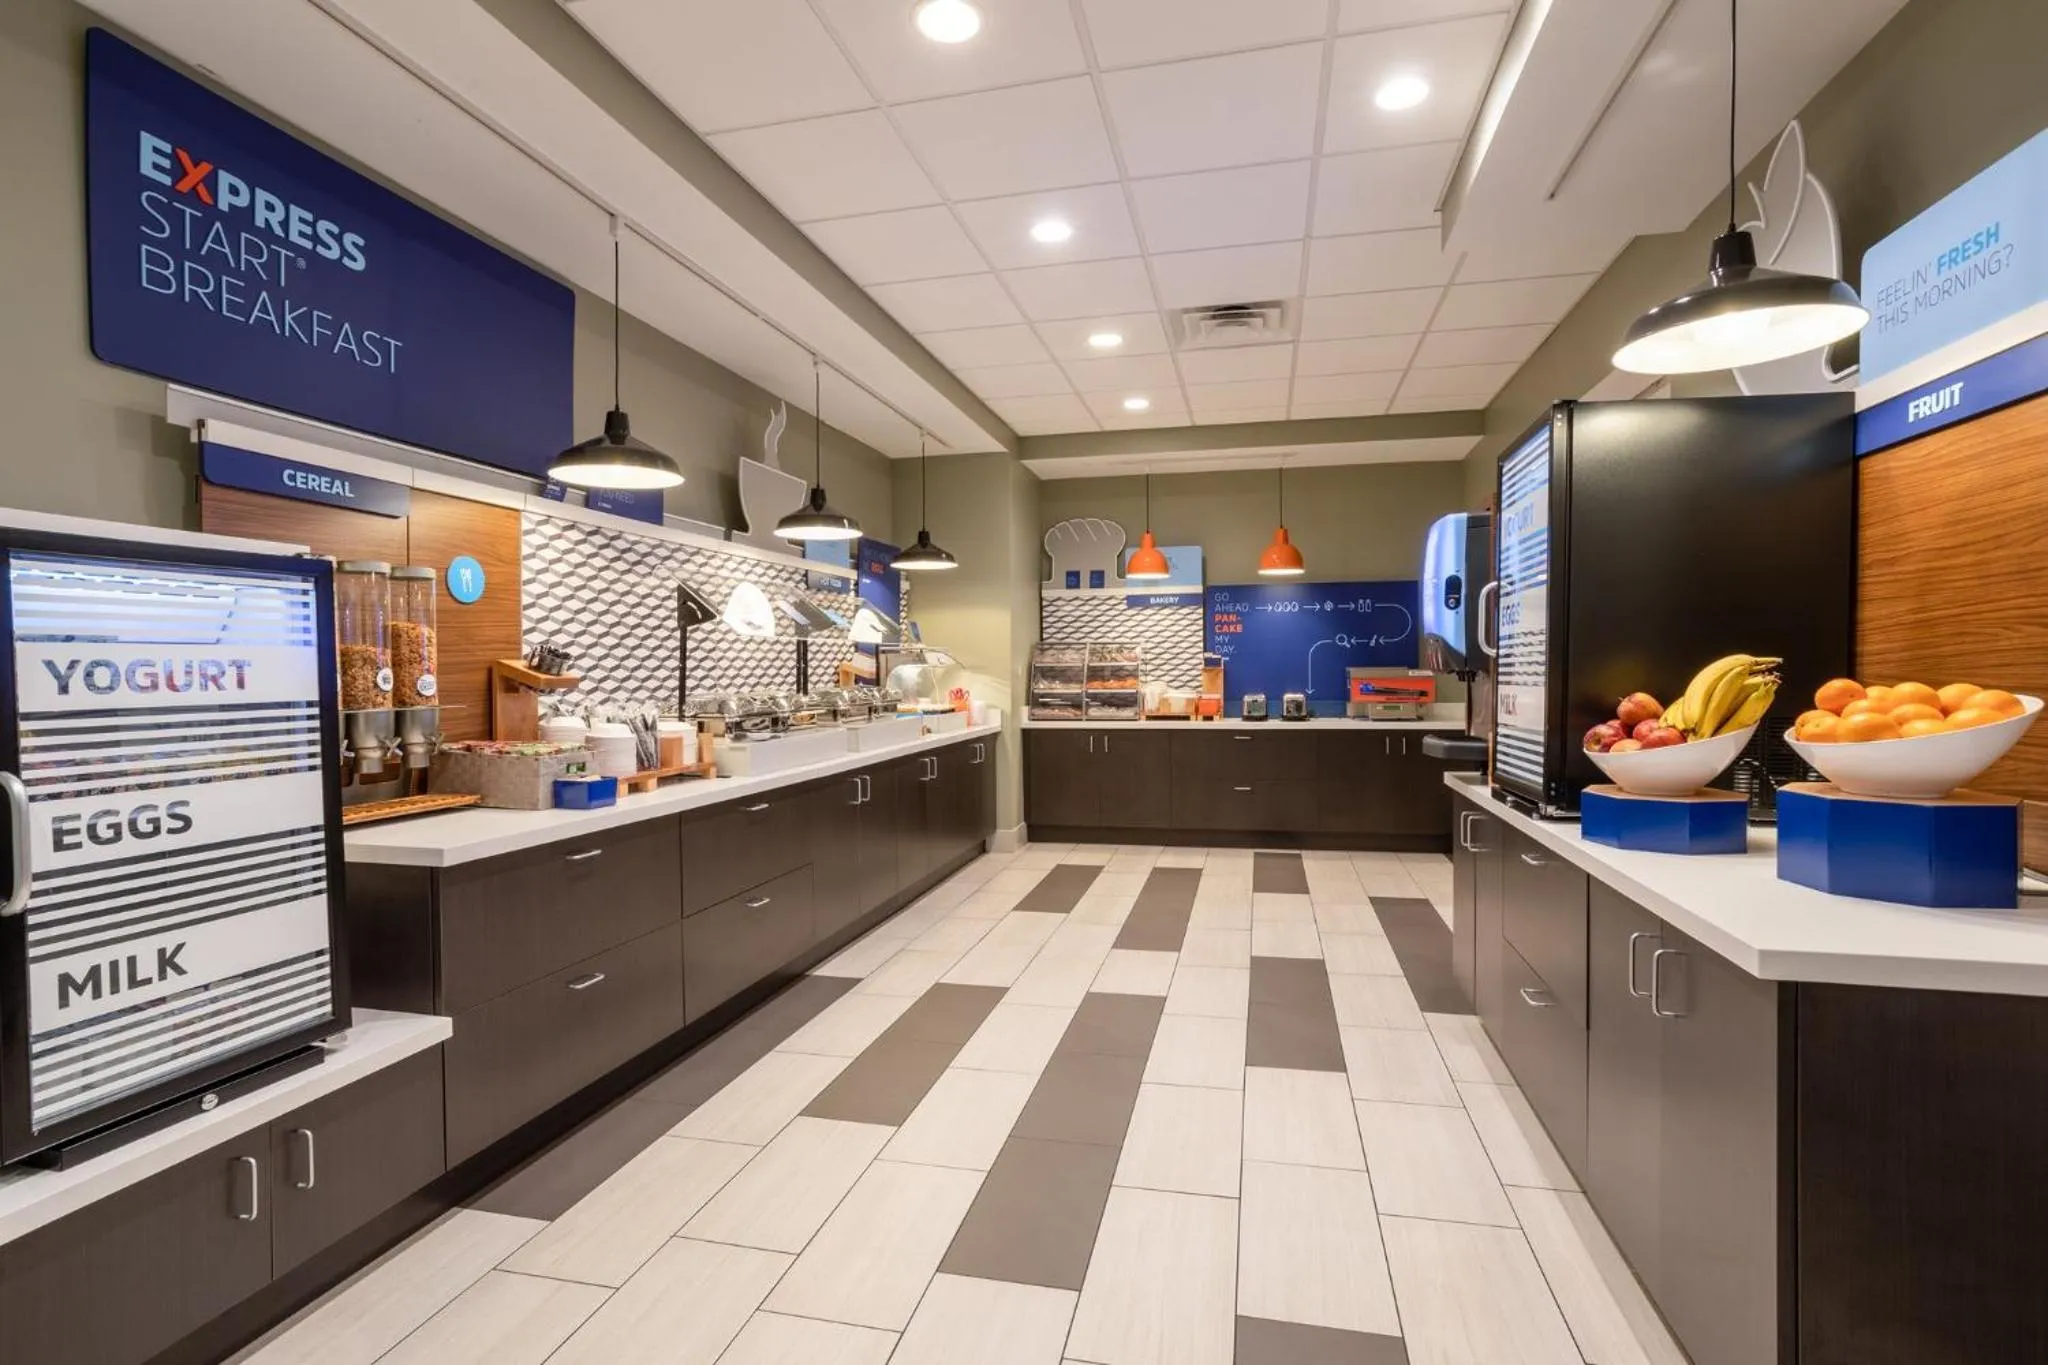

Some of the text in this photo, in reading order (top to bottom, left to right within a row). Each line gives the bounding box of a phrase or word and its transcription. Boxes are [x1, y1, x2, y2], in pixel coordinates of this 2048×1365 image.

[139, 130, 366, 272] EXPRESS
[1936, 221, 2001, 276] FRESH
[140, 244, 403, 374] BREAKFAST
[1877, 243, 2015, 335] THIS MORNING?
[1907, 382, 1965, 424] FRUIT
[282, 469, 355, 498] CEREAL
[1149, 596, 1180, 605] BAKERY
[1214, 592, 1230, 602] GO
[1214, 624, 1244, 633] CAKE
[1214, 634, 1230, 644] MY
[41, 658, 252, 696] YOGURT
[51, 799, 193, 853] EGGS
[57, 941, 189, 1011] MILK
